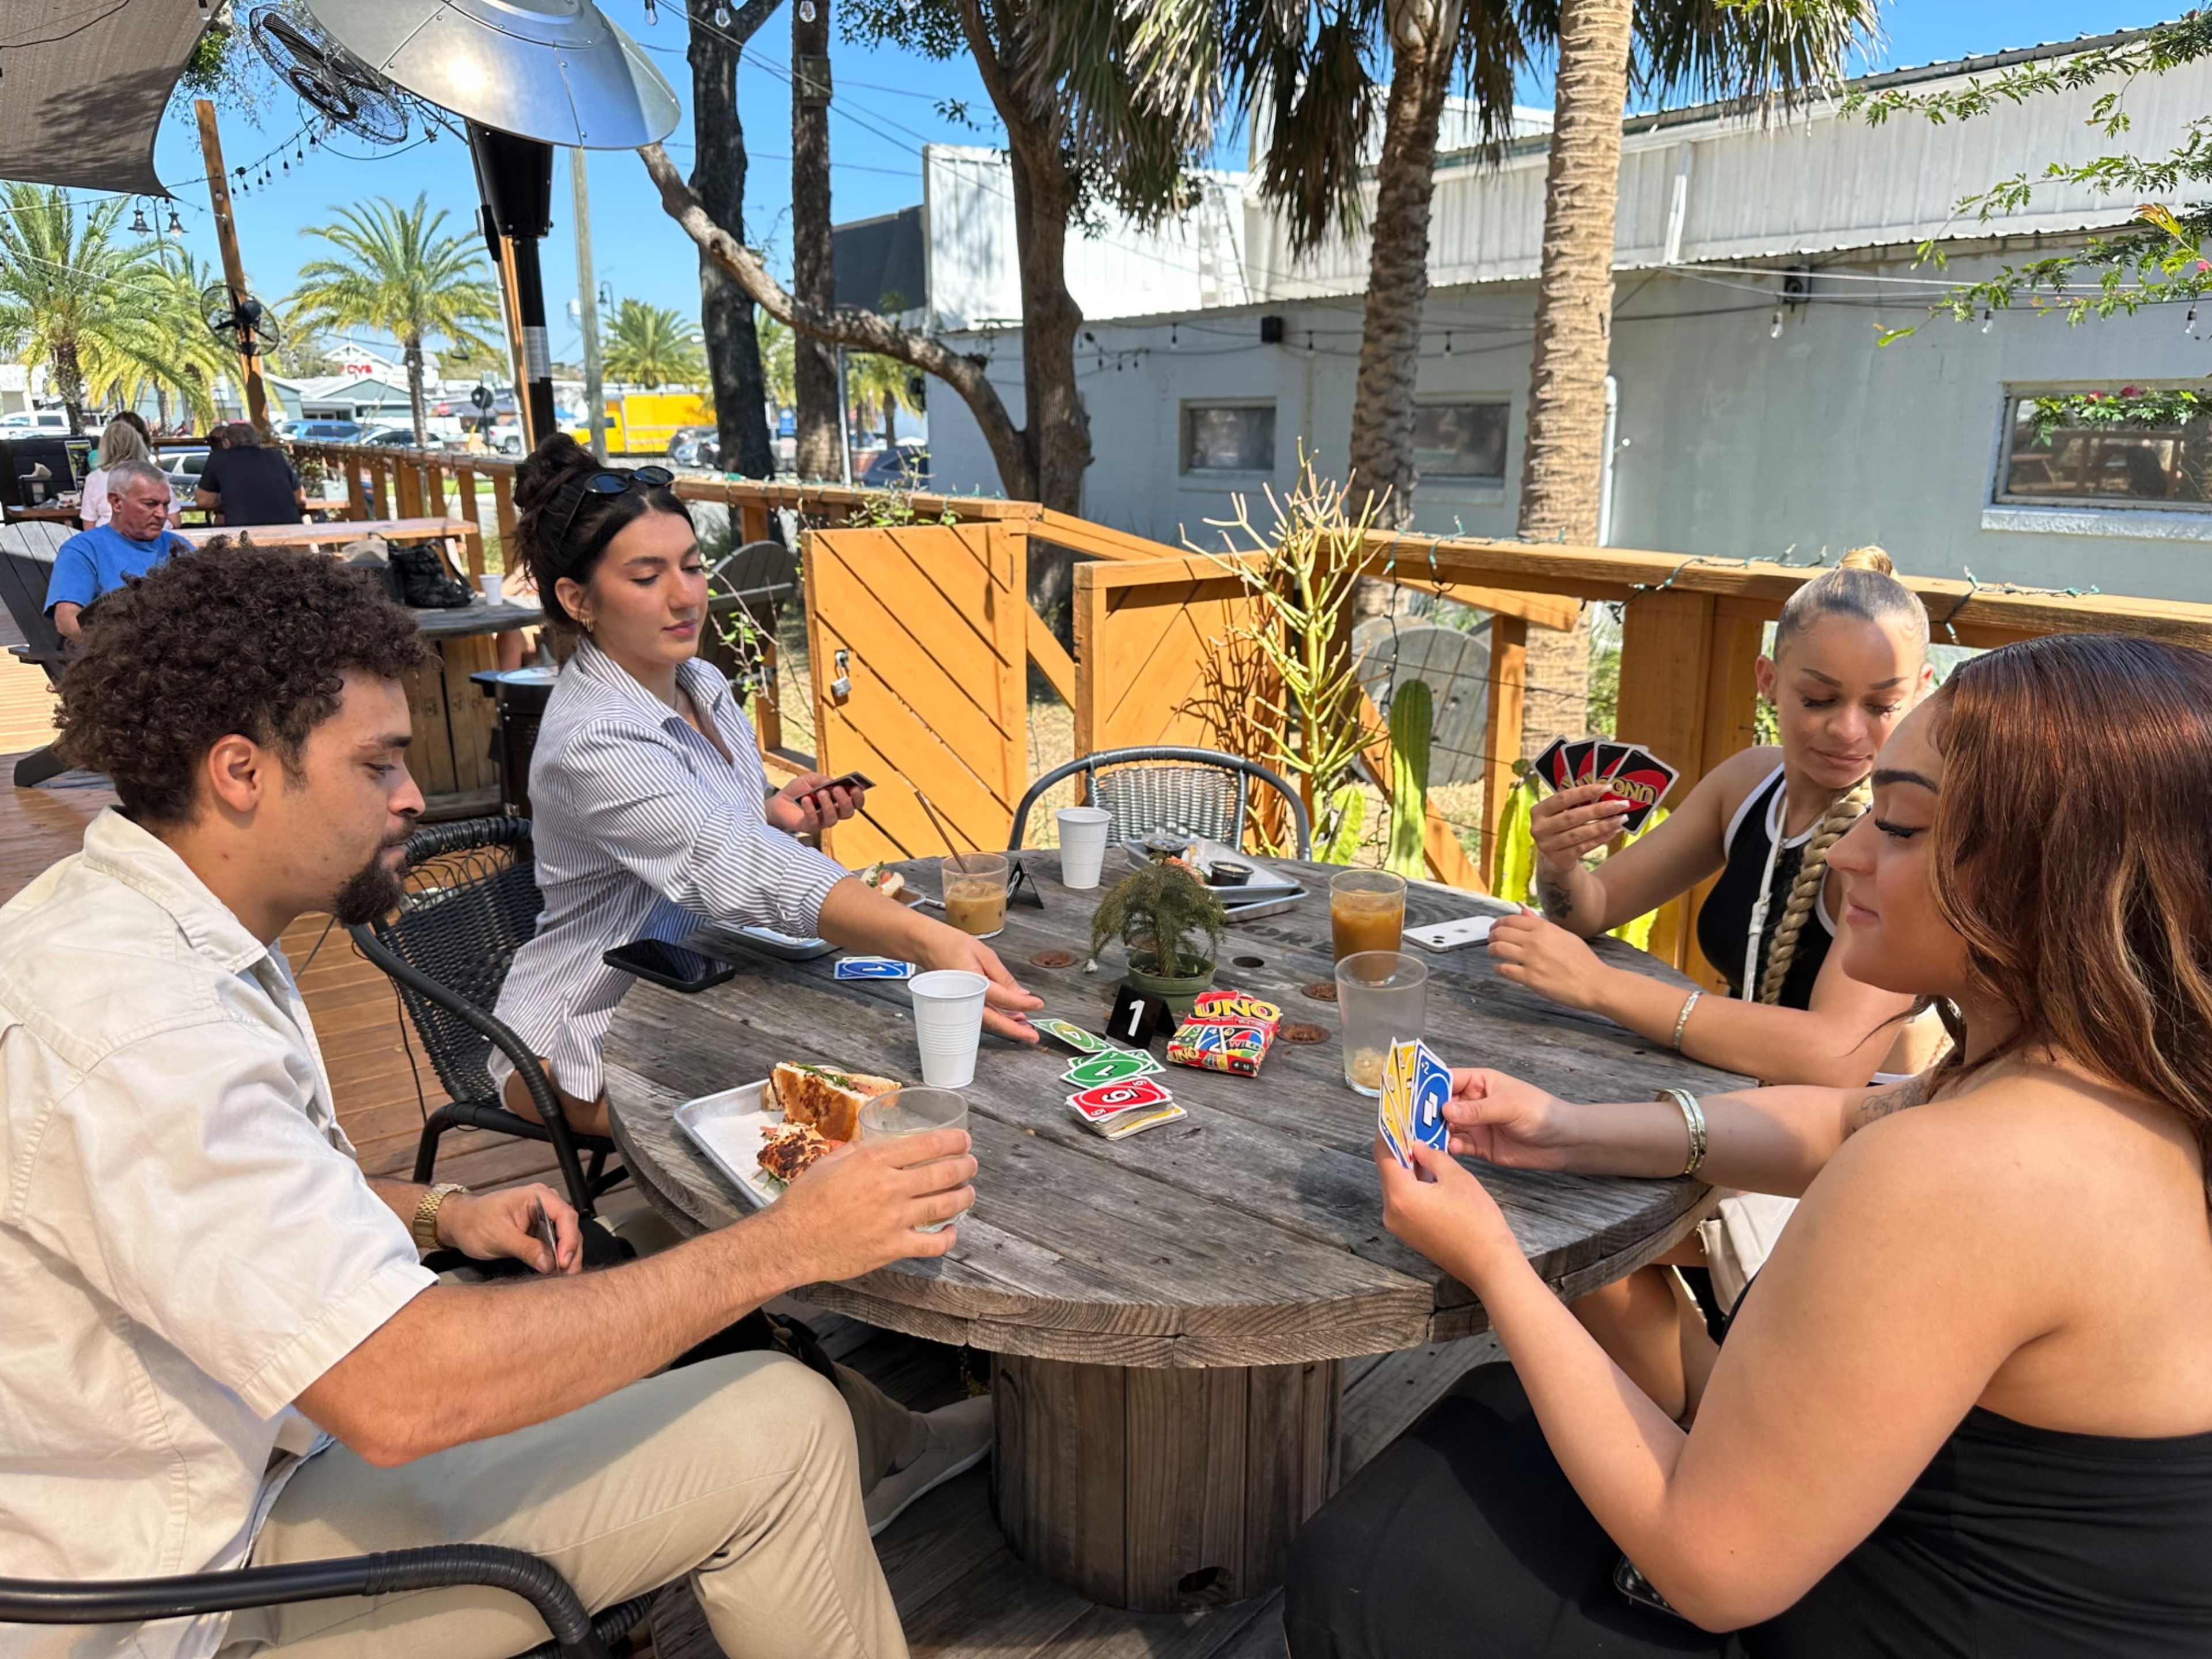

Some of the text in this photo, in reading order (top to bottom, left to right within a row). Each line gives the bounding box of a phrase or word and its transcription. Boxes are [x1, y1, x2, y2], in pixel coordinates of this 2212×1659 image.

[347, 364, 372, 374] CVS
[1612, 778, 1656, 804] UNO
[1007, 870, 1020, 899] 8
[1128, 999, 1145, 1036] 1
[1195, 999, 1280, 1022] UNO
[1421, 1061, 1429, 1075] +2
